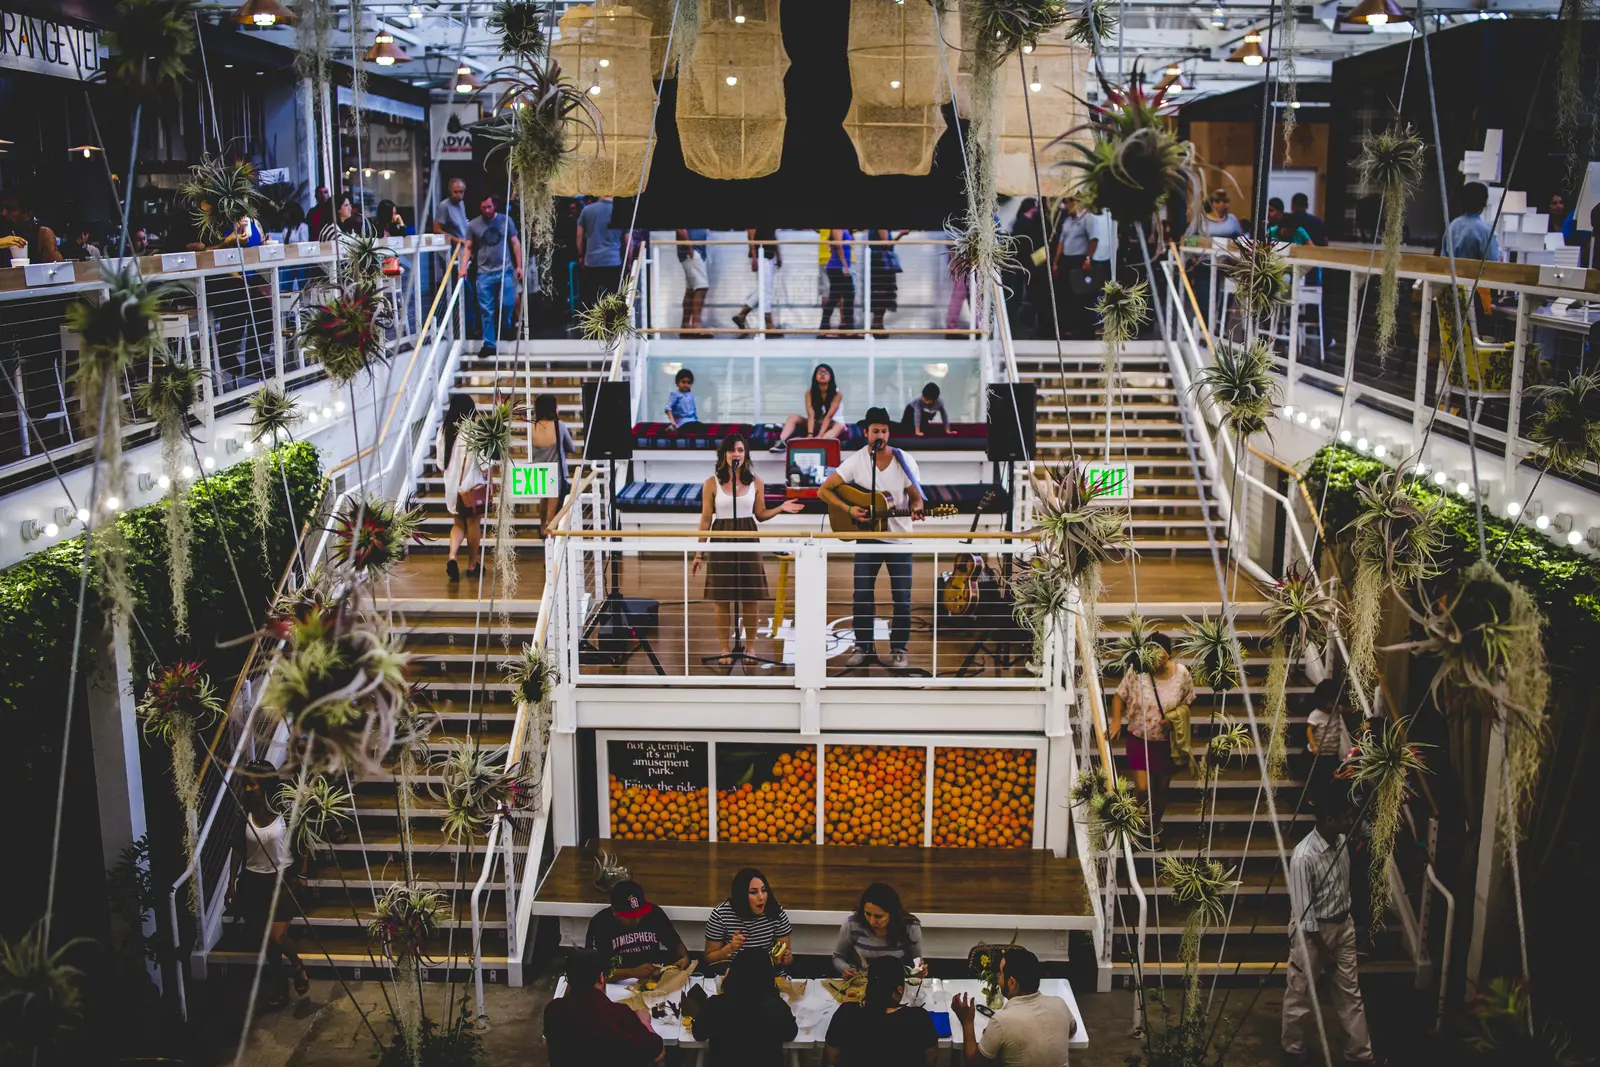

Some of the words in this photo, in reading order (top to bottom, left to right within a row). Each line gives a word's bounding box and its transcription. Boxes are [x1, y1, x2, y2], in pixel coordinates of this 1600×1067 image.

[512, 467, 548, 495] EXIT
[627, 741, 644, 750] not
[648, 742, 654, 750] a
[658, 741, 694, 753] temple,
[646, 748, 660, 758] it's
[663, 751, 676, 759] an
[632, 758, 689, 768] amusement
[648, 764, 674, 777] park.
[657, 780, 674, 791] the
[676, 781, 696, 792] ride
[612, 931, 658, 950] ATMOSPHERE
